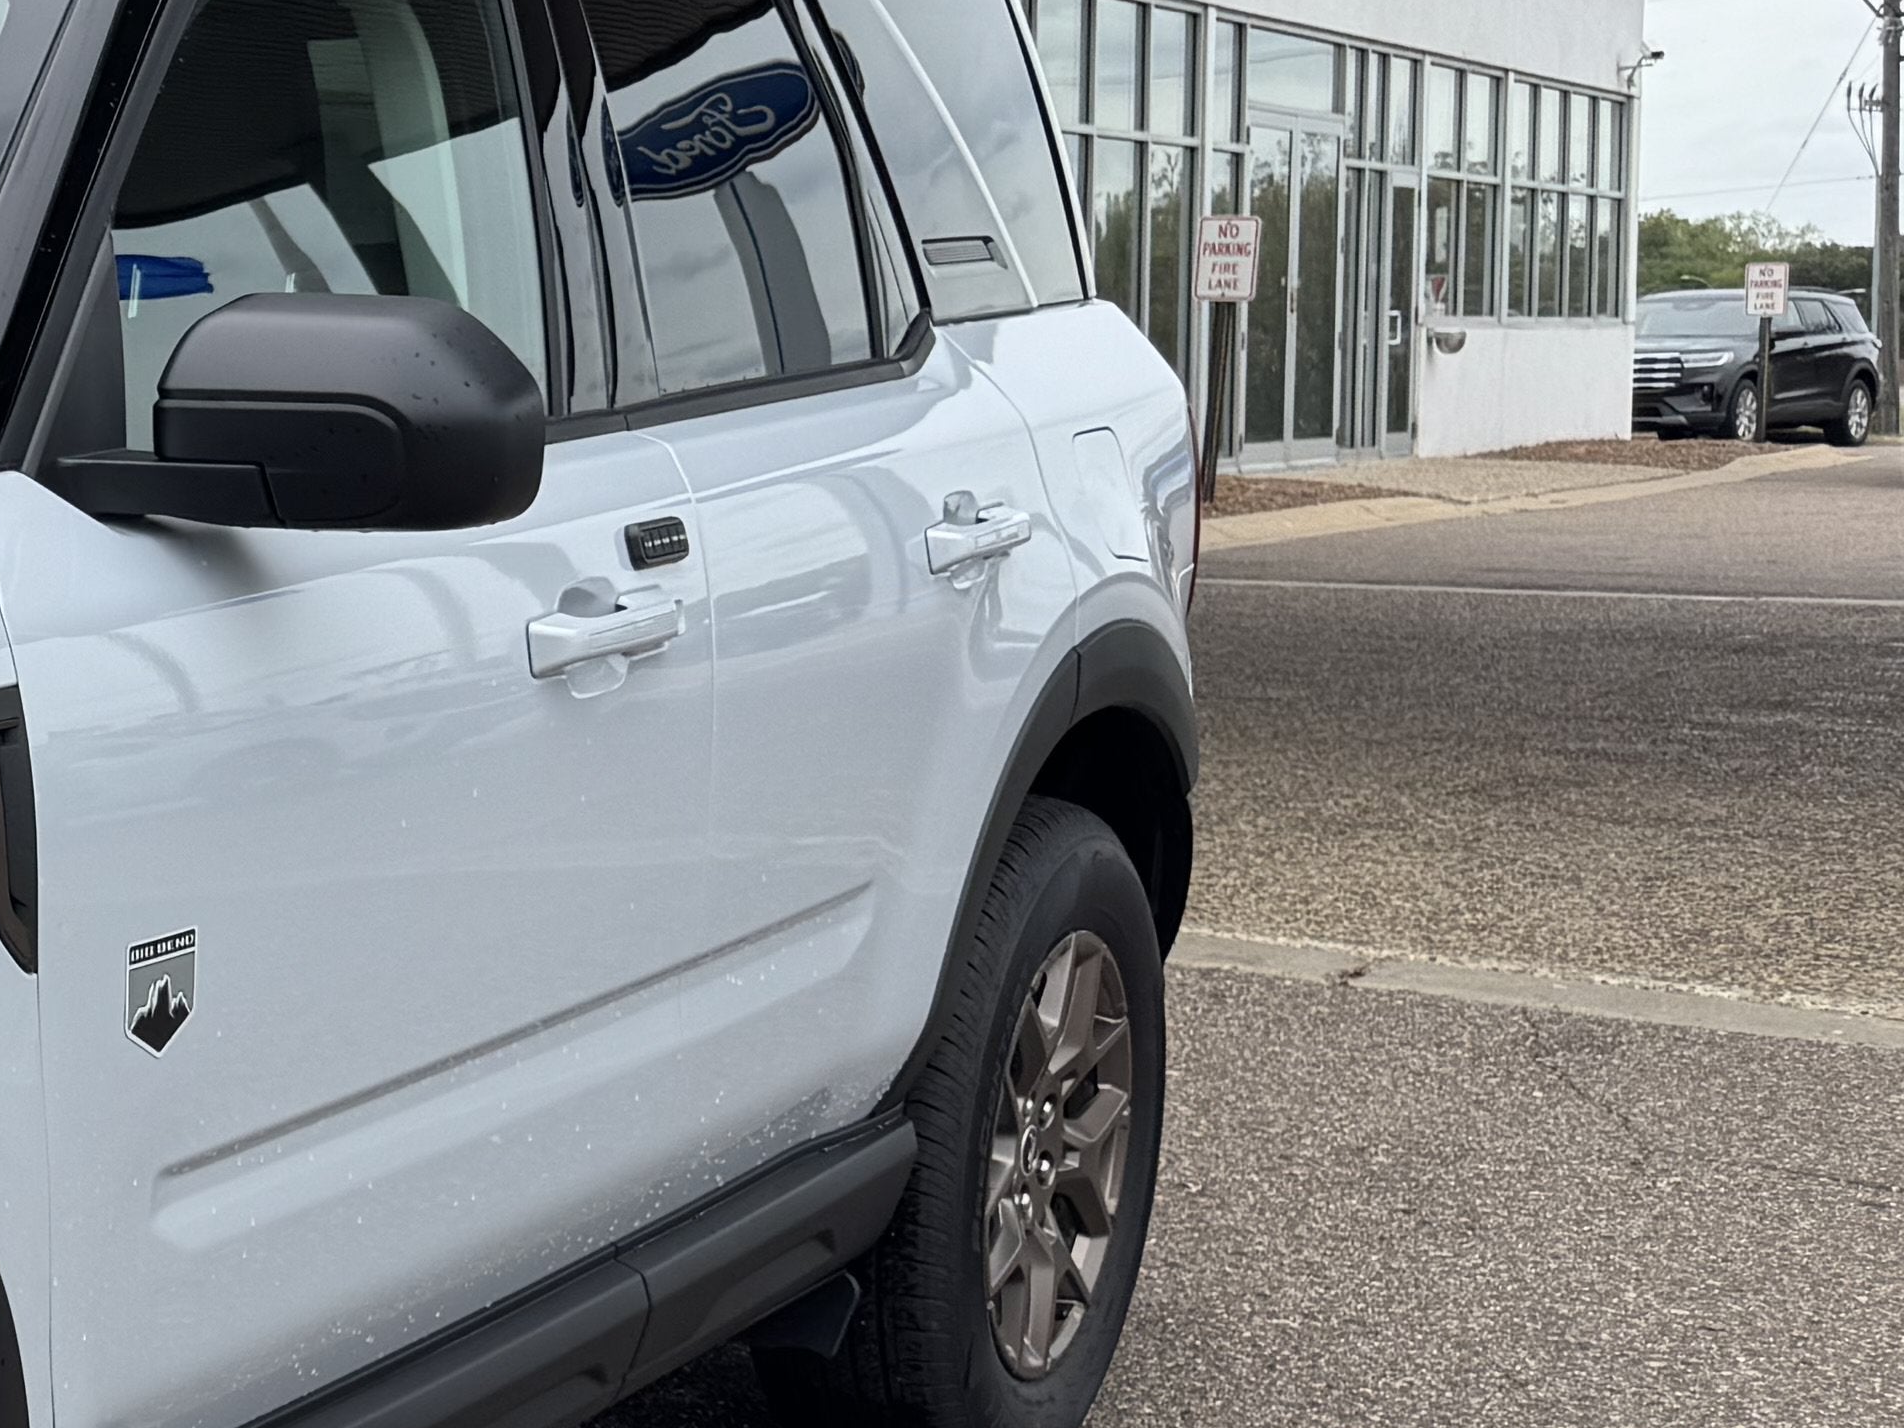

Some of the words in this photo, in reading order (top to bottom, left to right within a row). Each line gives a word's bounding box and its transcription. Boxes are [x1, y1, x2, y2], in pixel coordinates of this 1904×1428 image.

[1218, 224, 1240, 239] NO
[1202, 241, 1252, 258] PARKING
[1211, 261, 1239, 275] FIRE
[1759, 268, 1775, 278] NO
[1208, 278, 1240, 291] LANE
[1750, 278, 1783, 289] PARKING
